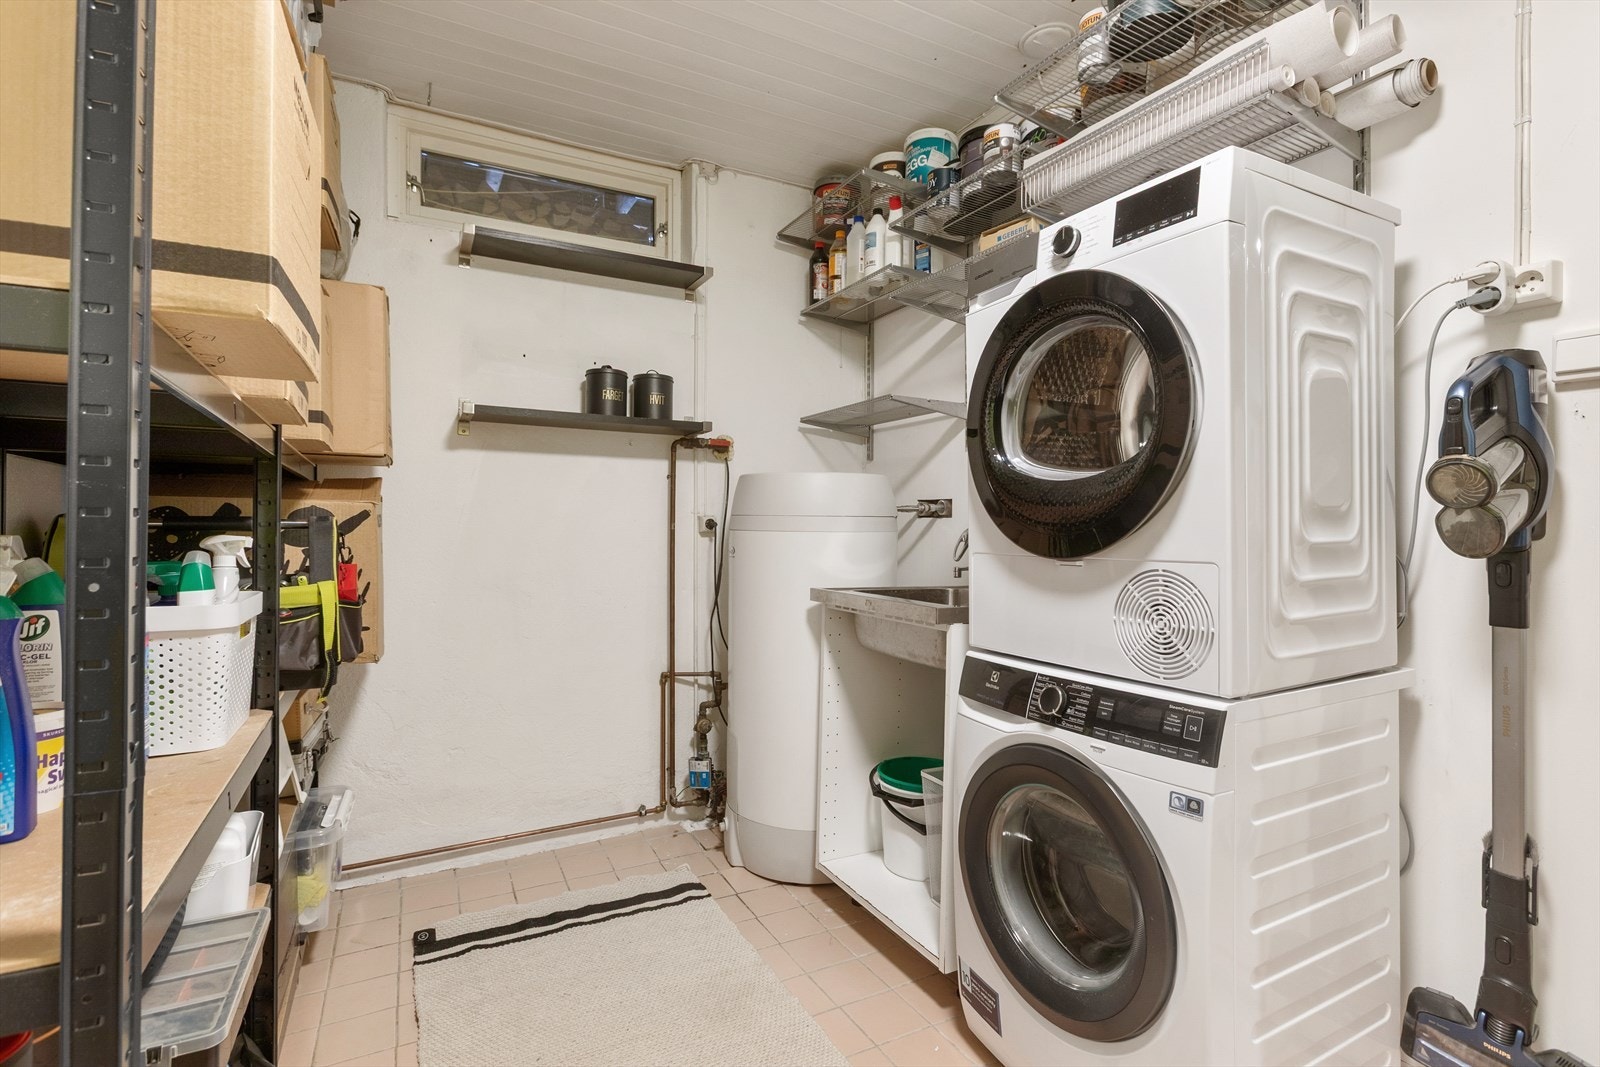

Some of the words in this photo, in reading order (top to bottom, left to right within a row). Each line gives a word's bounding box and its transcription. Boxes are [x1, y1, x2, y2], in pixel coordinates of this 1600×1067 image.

[1002, 224, 1029, 241] GEBERIT
[602, 389, 624, 402] FARGET
[649, 394, 665, 405] HVIT
[1483, 1041, 1512, 1060] PHILIPS
